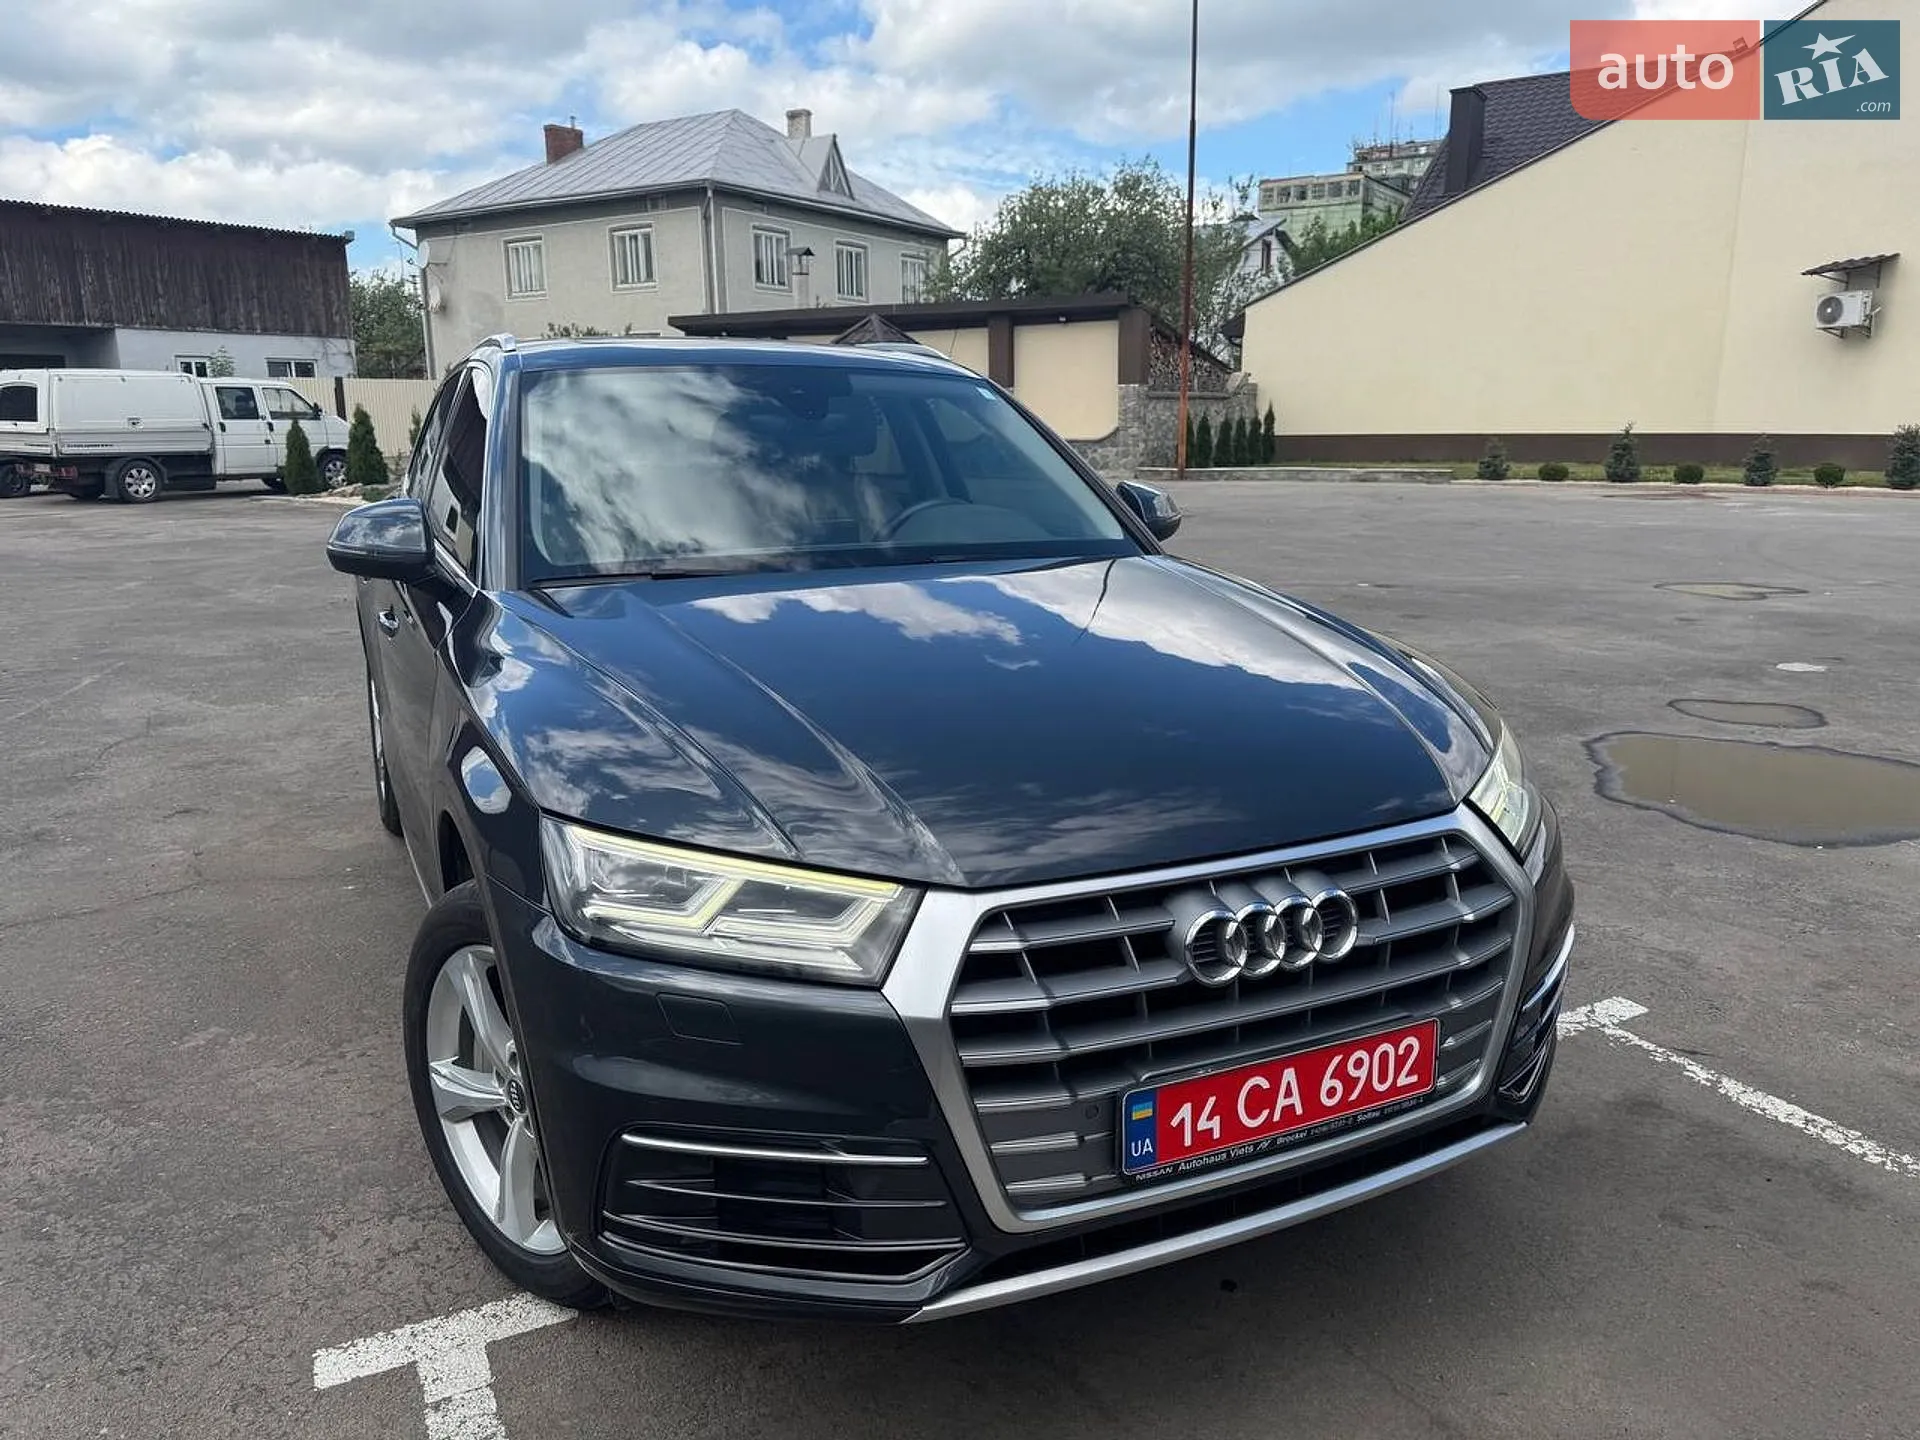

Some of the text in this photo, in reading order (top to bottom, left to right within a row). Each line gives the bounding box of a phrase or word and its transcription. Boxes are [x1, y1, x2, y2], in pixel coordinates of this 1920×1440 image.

[1170, 1035, 1421, 1147] 14 CA 6902
[1131, 1138, 1153, 1157] UA
[1136, 1167, 1173, 1181] NISSAN
[1179, 1153, 1227, 1172] Autohaus
